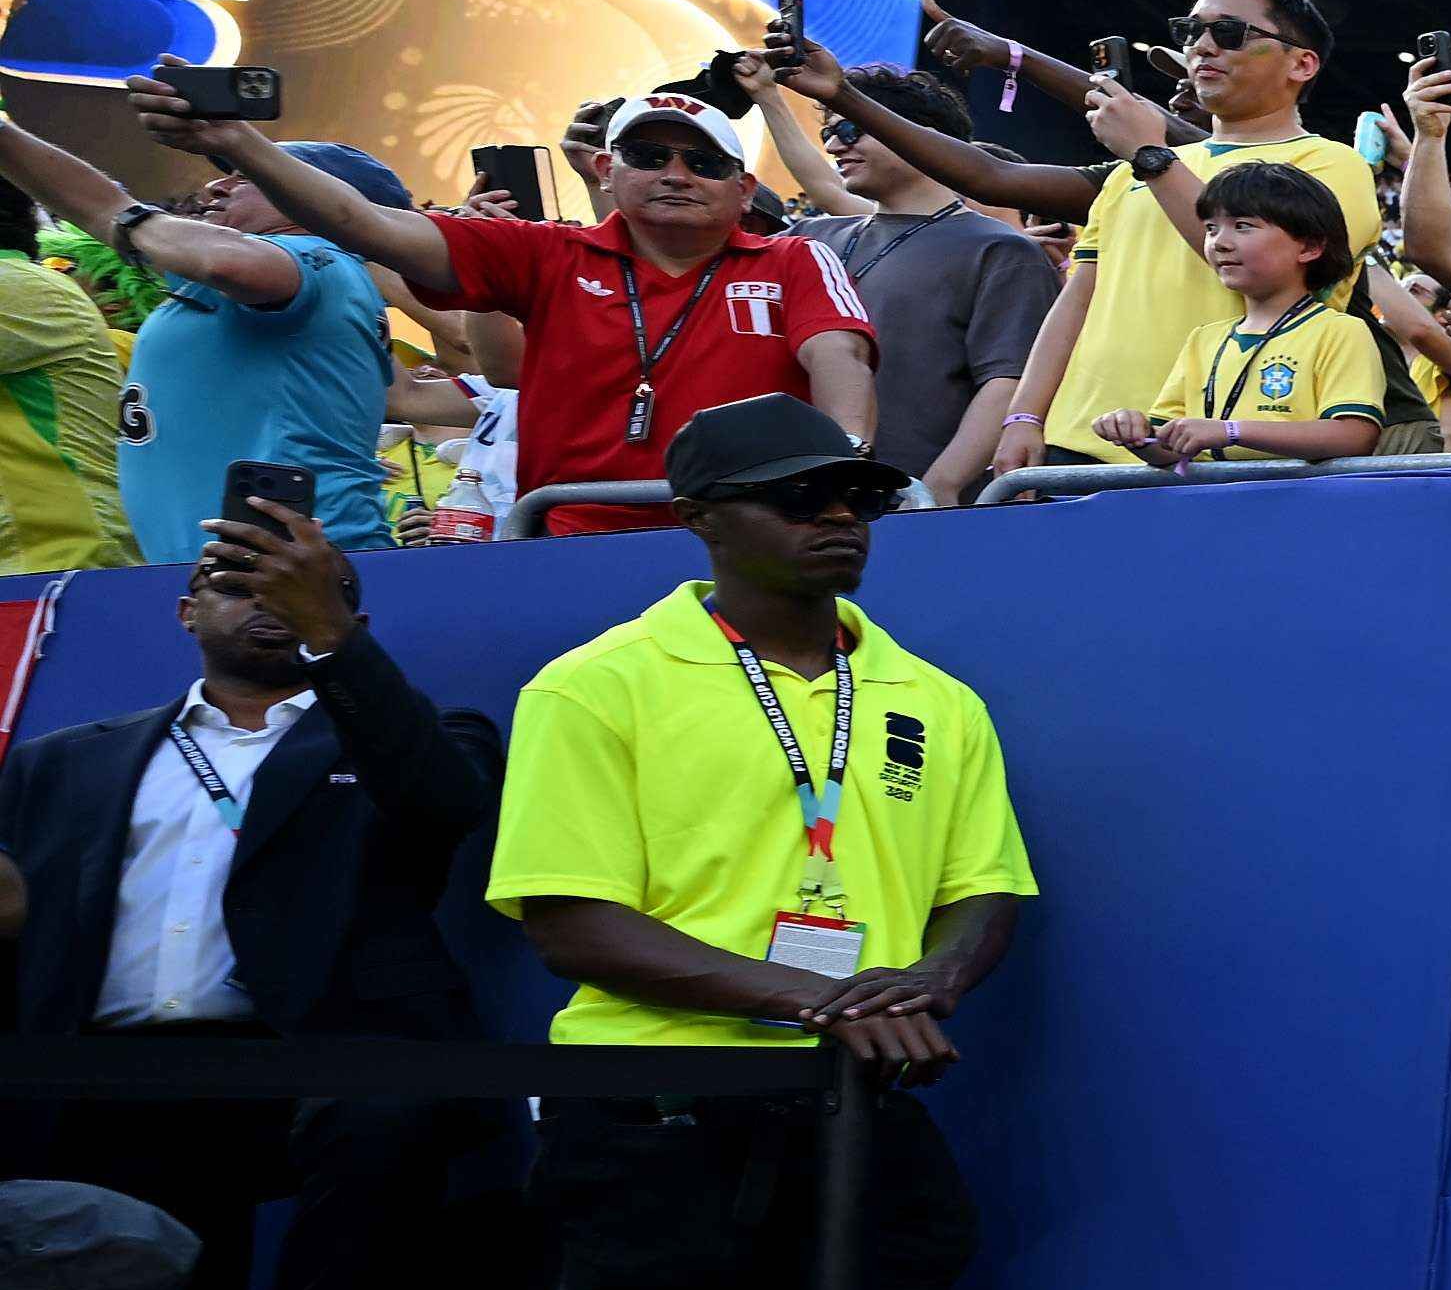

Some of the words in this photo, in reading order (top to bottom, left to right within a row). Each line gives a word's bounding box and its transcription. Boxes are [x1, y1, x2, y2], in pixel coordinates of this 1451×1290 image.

[732, 284, 778, 296] FPF
[1257, 405, 1292, 413] BRASIL
[837, 671, 852, 708] WORLD
[835, 709, 851, 730] CUP
